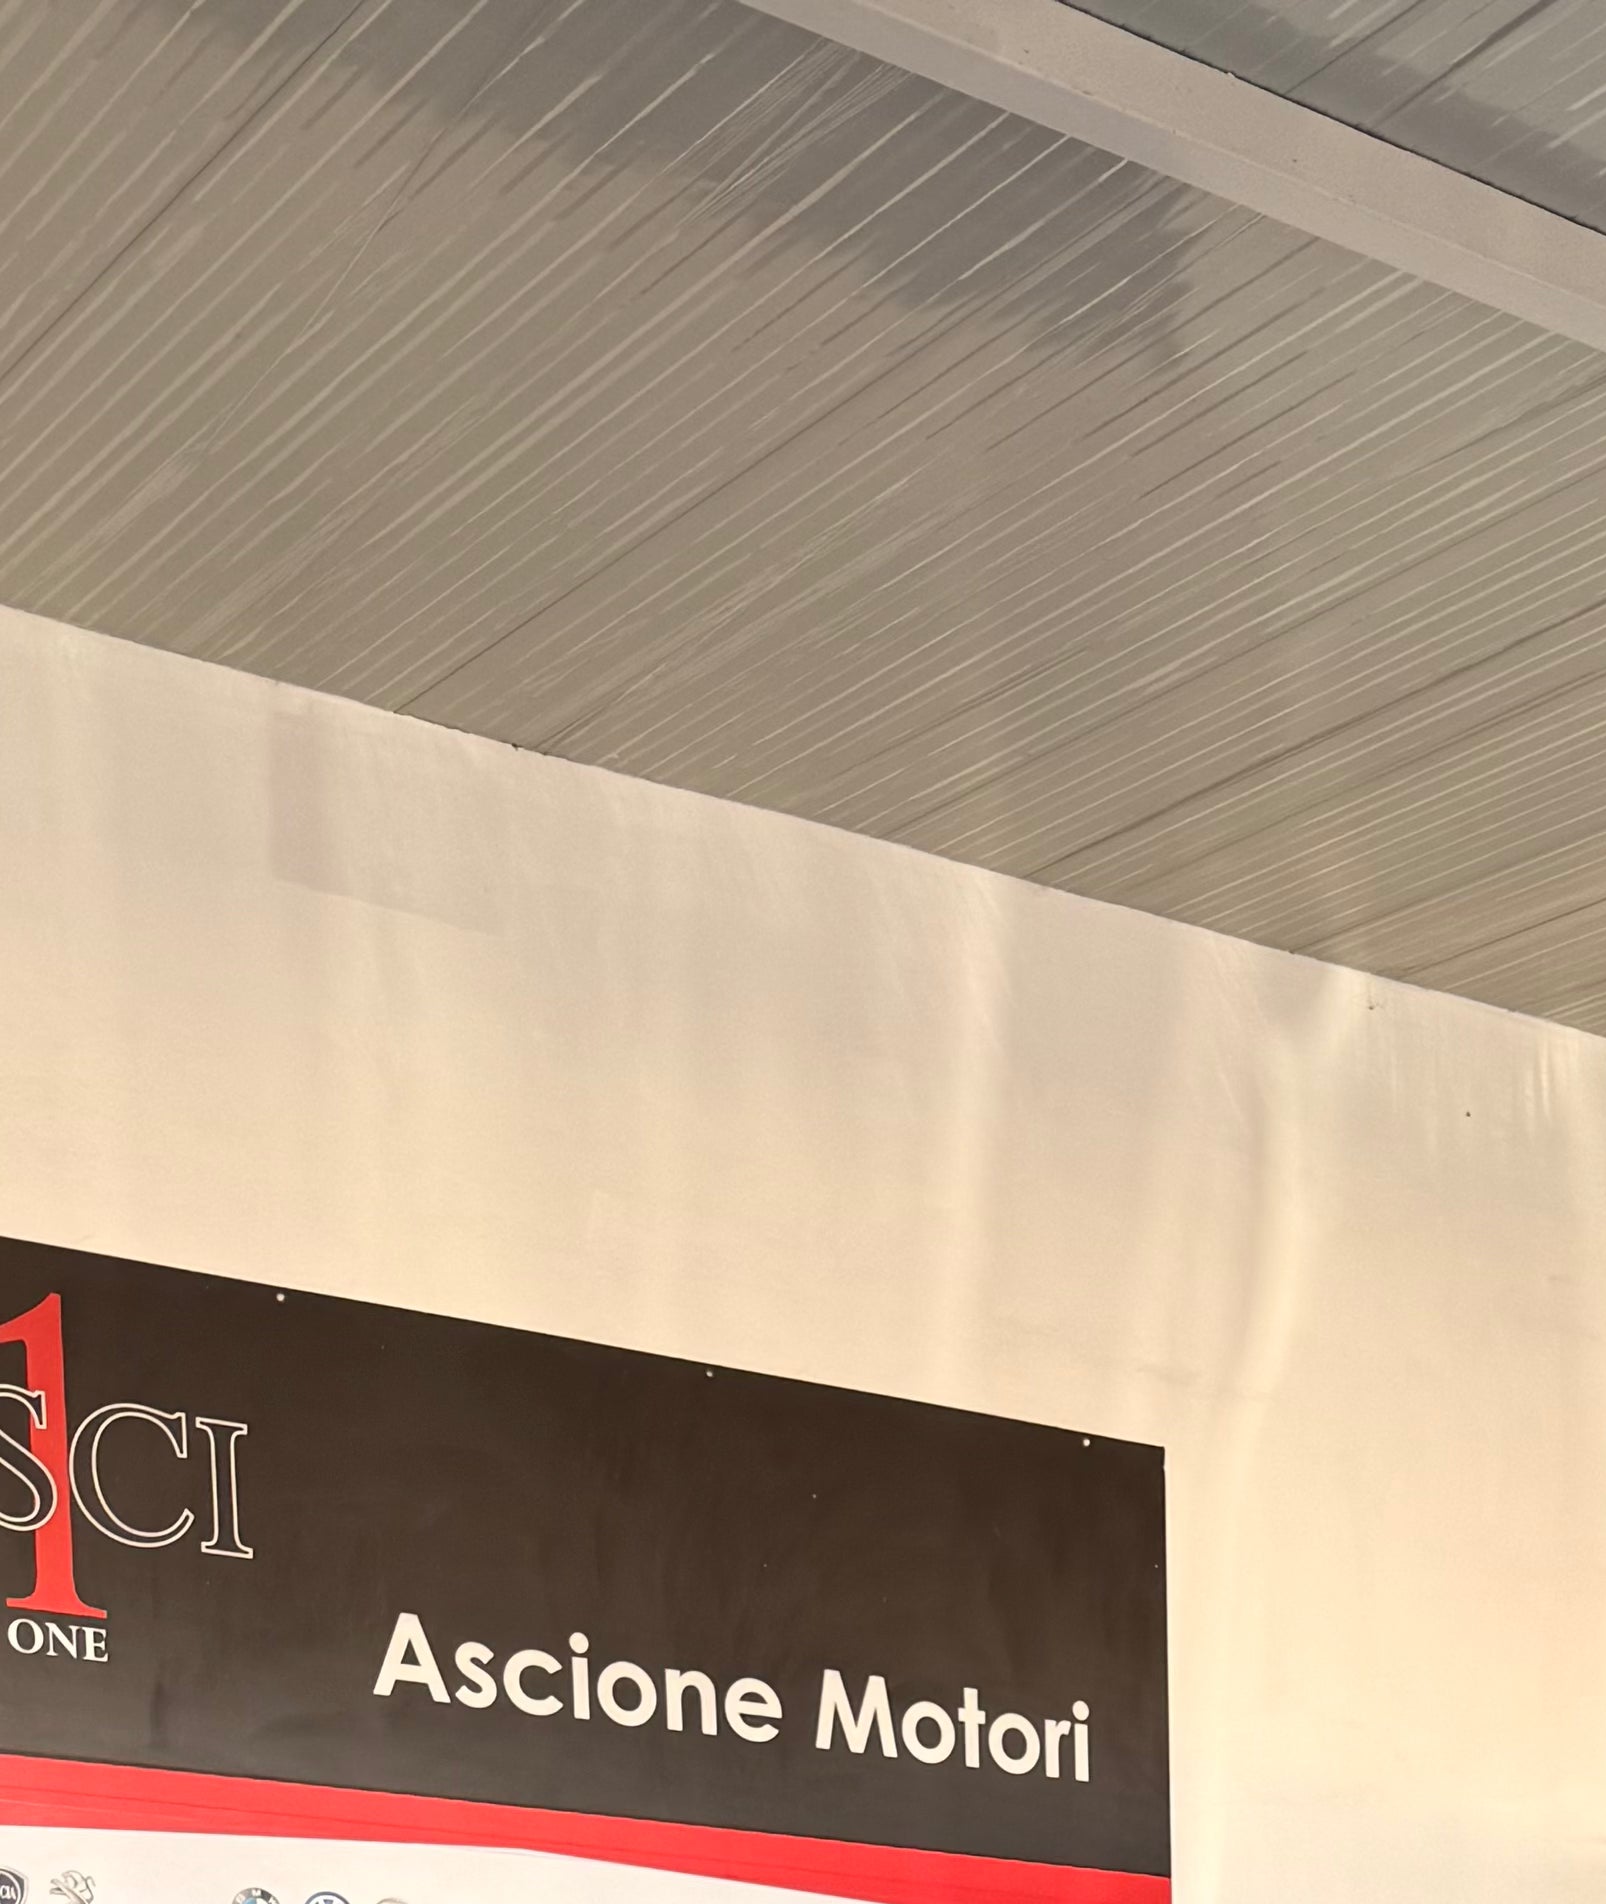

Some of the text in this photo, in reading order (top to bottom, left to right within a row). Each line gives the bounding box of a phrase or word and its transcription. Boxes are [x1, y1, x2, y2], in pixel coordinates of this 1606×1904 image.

[0, 1383, 253, 1559] SCI
[7, 1618, 109, 1662] ONE
[373, 1612, 1090, 1782] Ascione Motori
